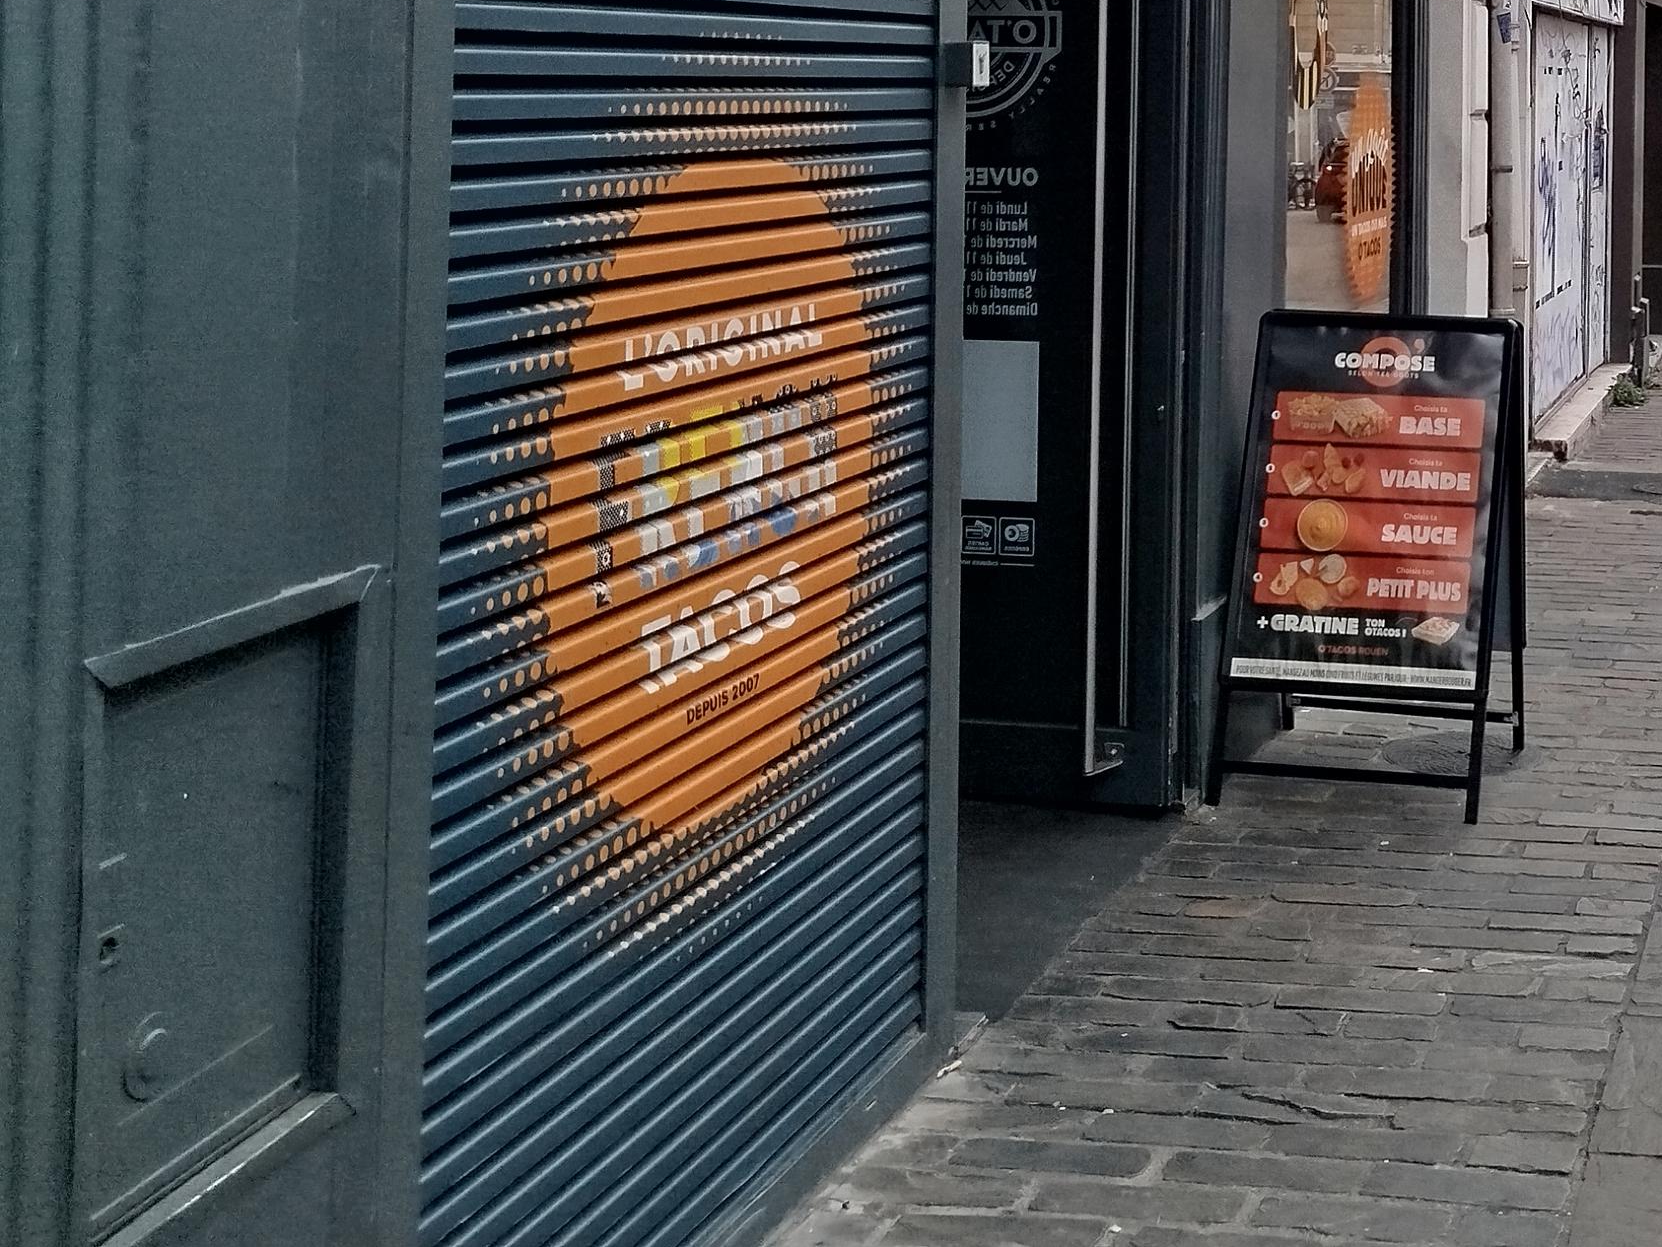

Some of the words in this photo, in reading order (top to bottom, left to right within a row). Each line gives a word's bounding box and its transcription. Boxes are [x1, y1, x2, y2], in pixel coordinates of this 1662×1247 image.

[618, 303, 823, 391] L'ORIGINAL
[1334, 352, 1436, 373] COMPOSE
[1399, 416, 1461, 437] BASE
[1408, 457, 1434, 466] Choisis
[1380, 468, 1471, 491] VIANDE
[1403, 512, 1428, 521] Choisis
[1381, 524, 1457, 546] SAUCE
[1366, 578, 1415, 599] PETIT
[1416, 581, 1462, 602] PLUS
[639, 560, 802, 694] TACOS
[1365, 618, 1386, 628] TON
[686, 691, 729, 726] DEPUIS
[732, 673, 761, 704] 2007
